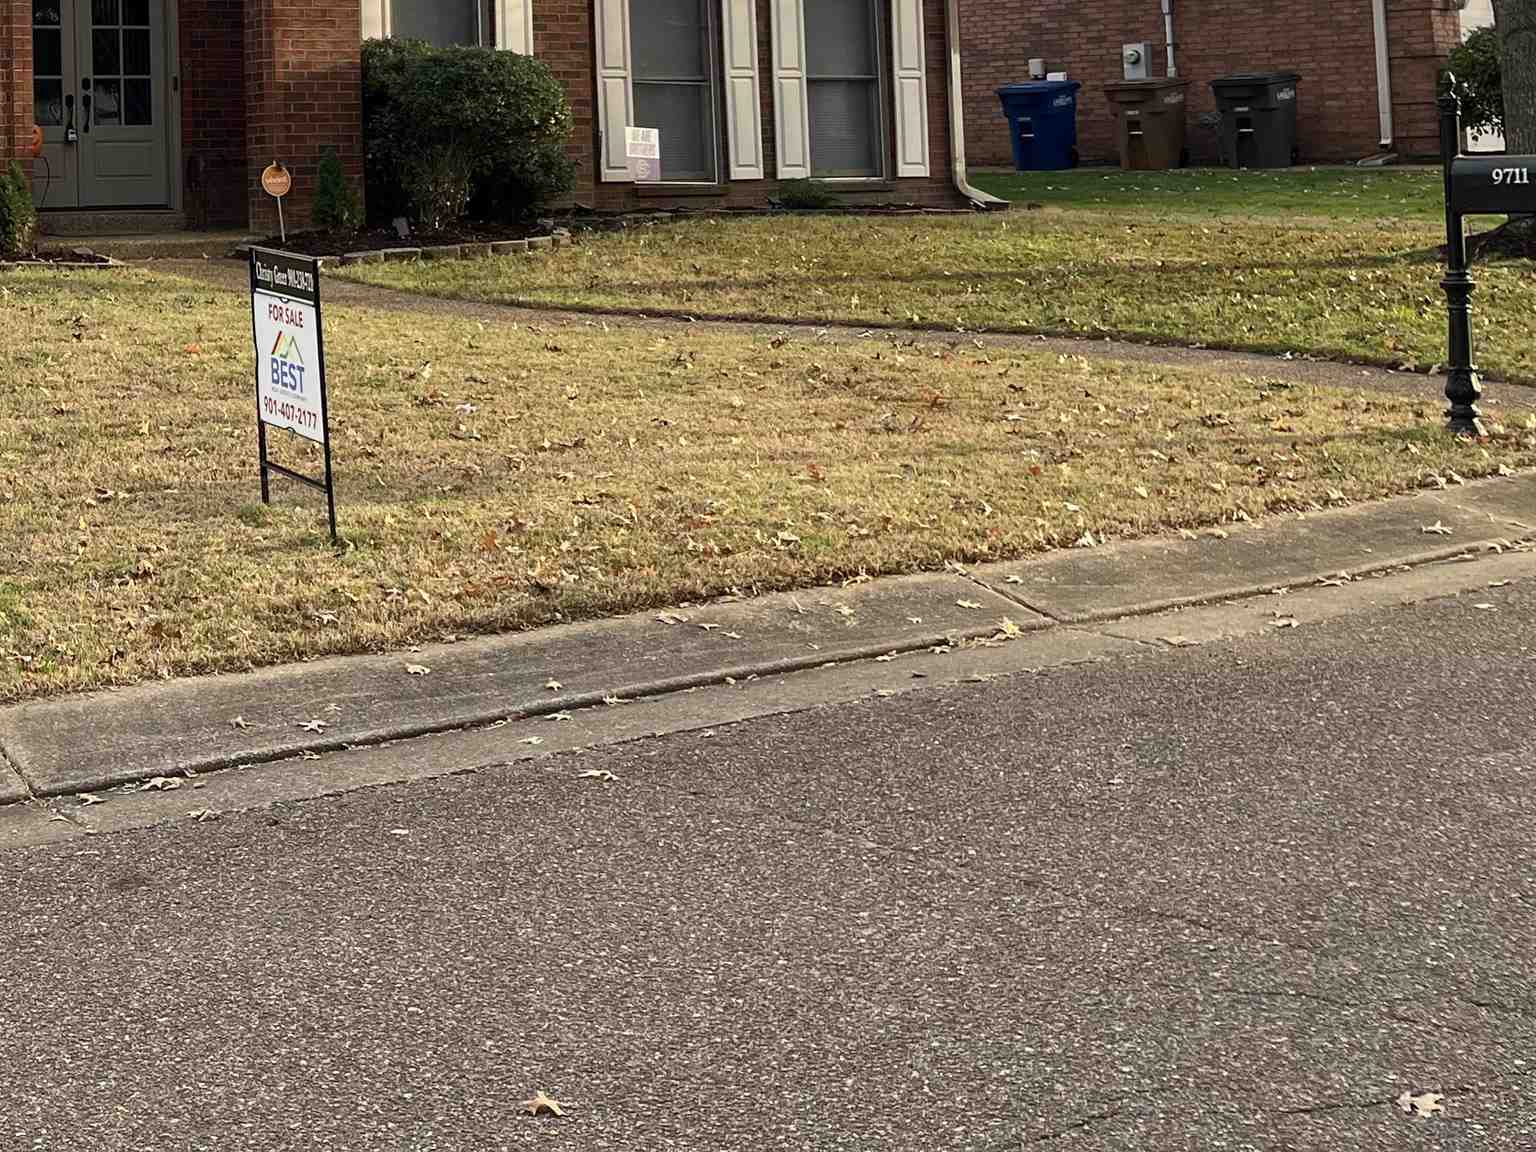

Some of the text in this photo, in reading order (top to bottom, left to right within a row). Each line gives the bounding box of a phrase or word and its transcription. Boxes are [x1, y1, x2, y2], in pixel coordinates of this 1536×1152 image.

[1491, 167, 1529, 185] 9711
[268, 303, 304, 328] FOR SALE
[271, 357, 305, 393] BEST
[263, 395, 318, 431] 901-407-2177
